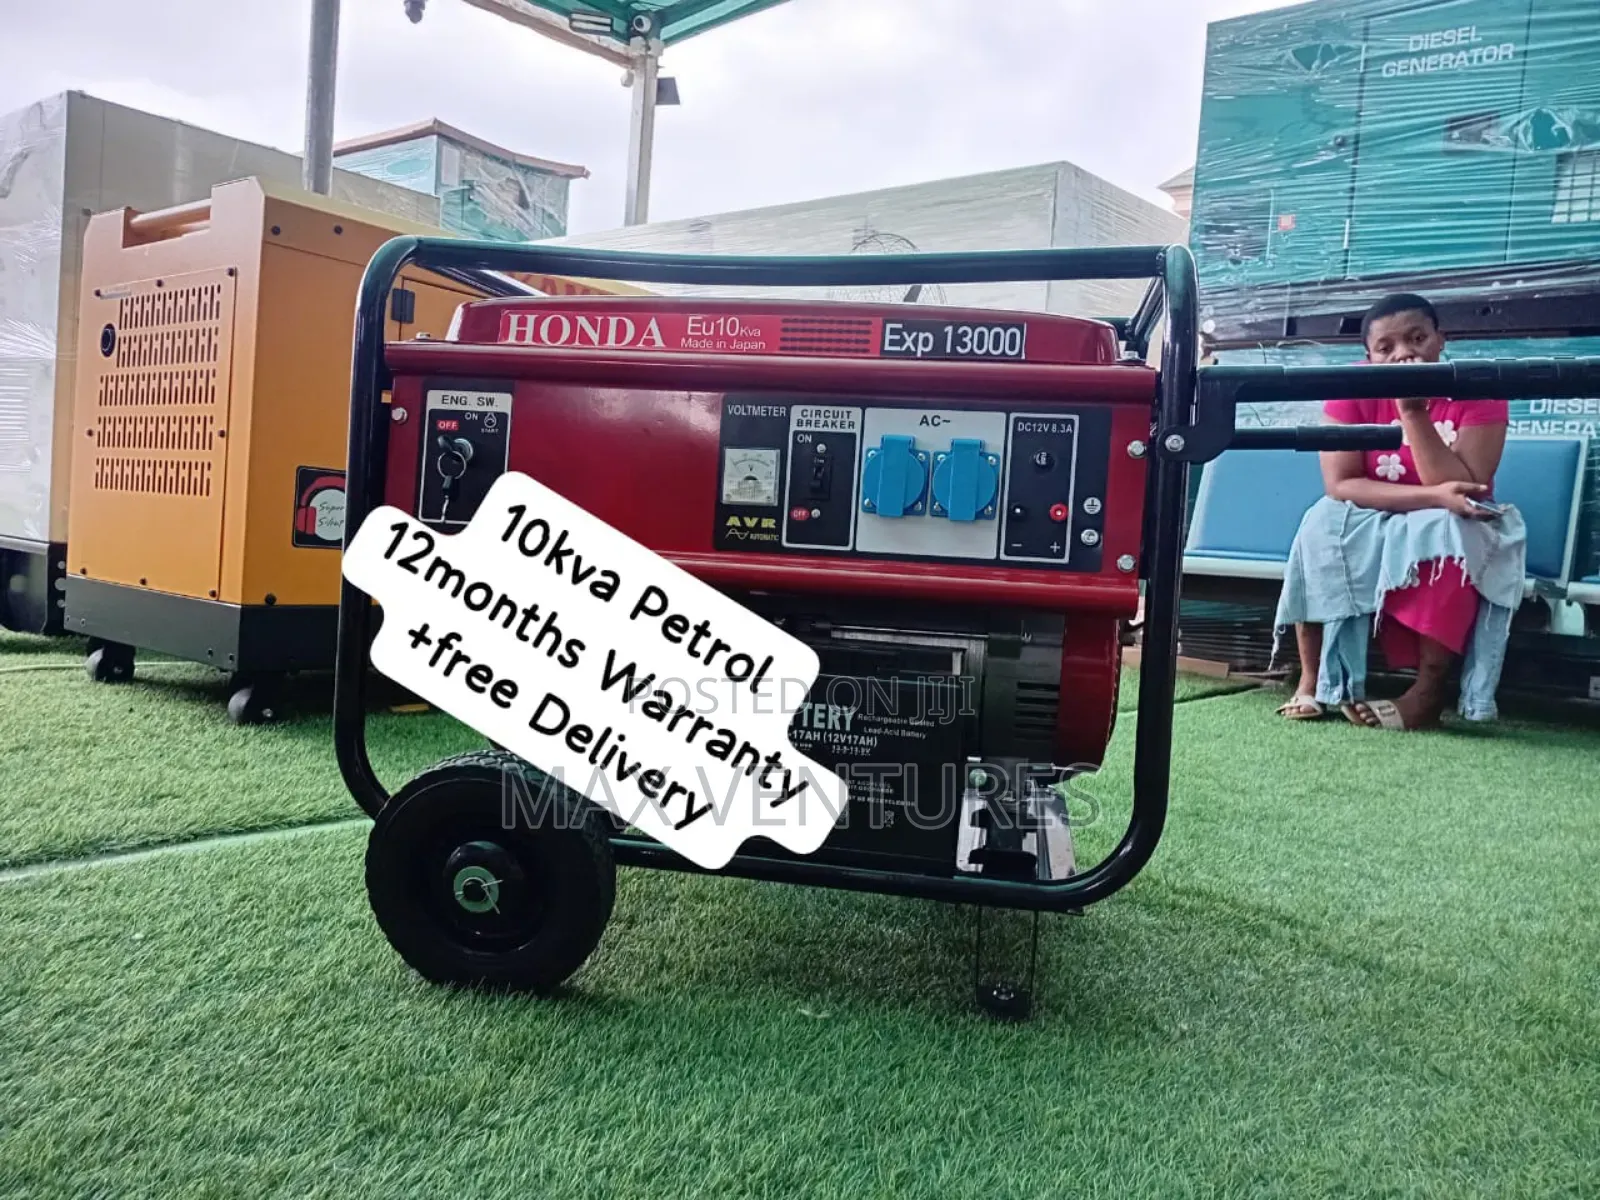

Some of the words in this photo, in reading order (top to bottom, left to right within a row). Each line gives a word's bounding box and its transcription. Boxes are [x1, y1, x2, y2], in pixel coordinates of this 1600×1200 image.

[1408, 25, 1482, 52] DIESEL
[1382, 42, 1515, 78] GENERATOR
[506, 313, 666, 348] HONDA
[680, 337, 713, 349] Made
[716, 340, 726, 349] in
[730, 339, 766, 352] Japan
[884, 323, 934, 358] Exp
[944, 324, 1022, 357] 13000
[727, 404, 787, 418] VOLTMETER
[1529, 398, 1600, 414] DIESE
[464, 412, 479, 421] ON
[800, 409, 853, 419] CIRCUIT
[437, 421, 458, 431] OFF
[796, 419, 856, 429] BREAKER
[1508, 420, 1600, 439] ENERA
[797, 434, 812, 444] ON
[726, 516, 776, 529] AVR
[789, 702, 857, 732] TERY
